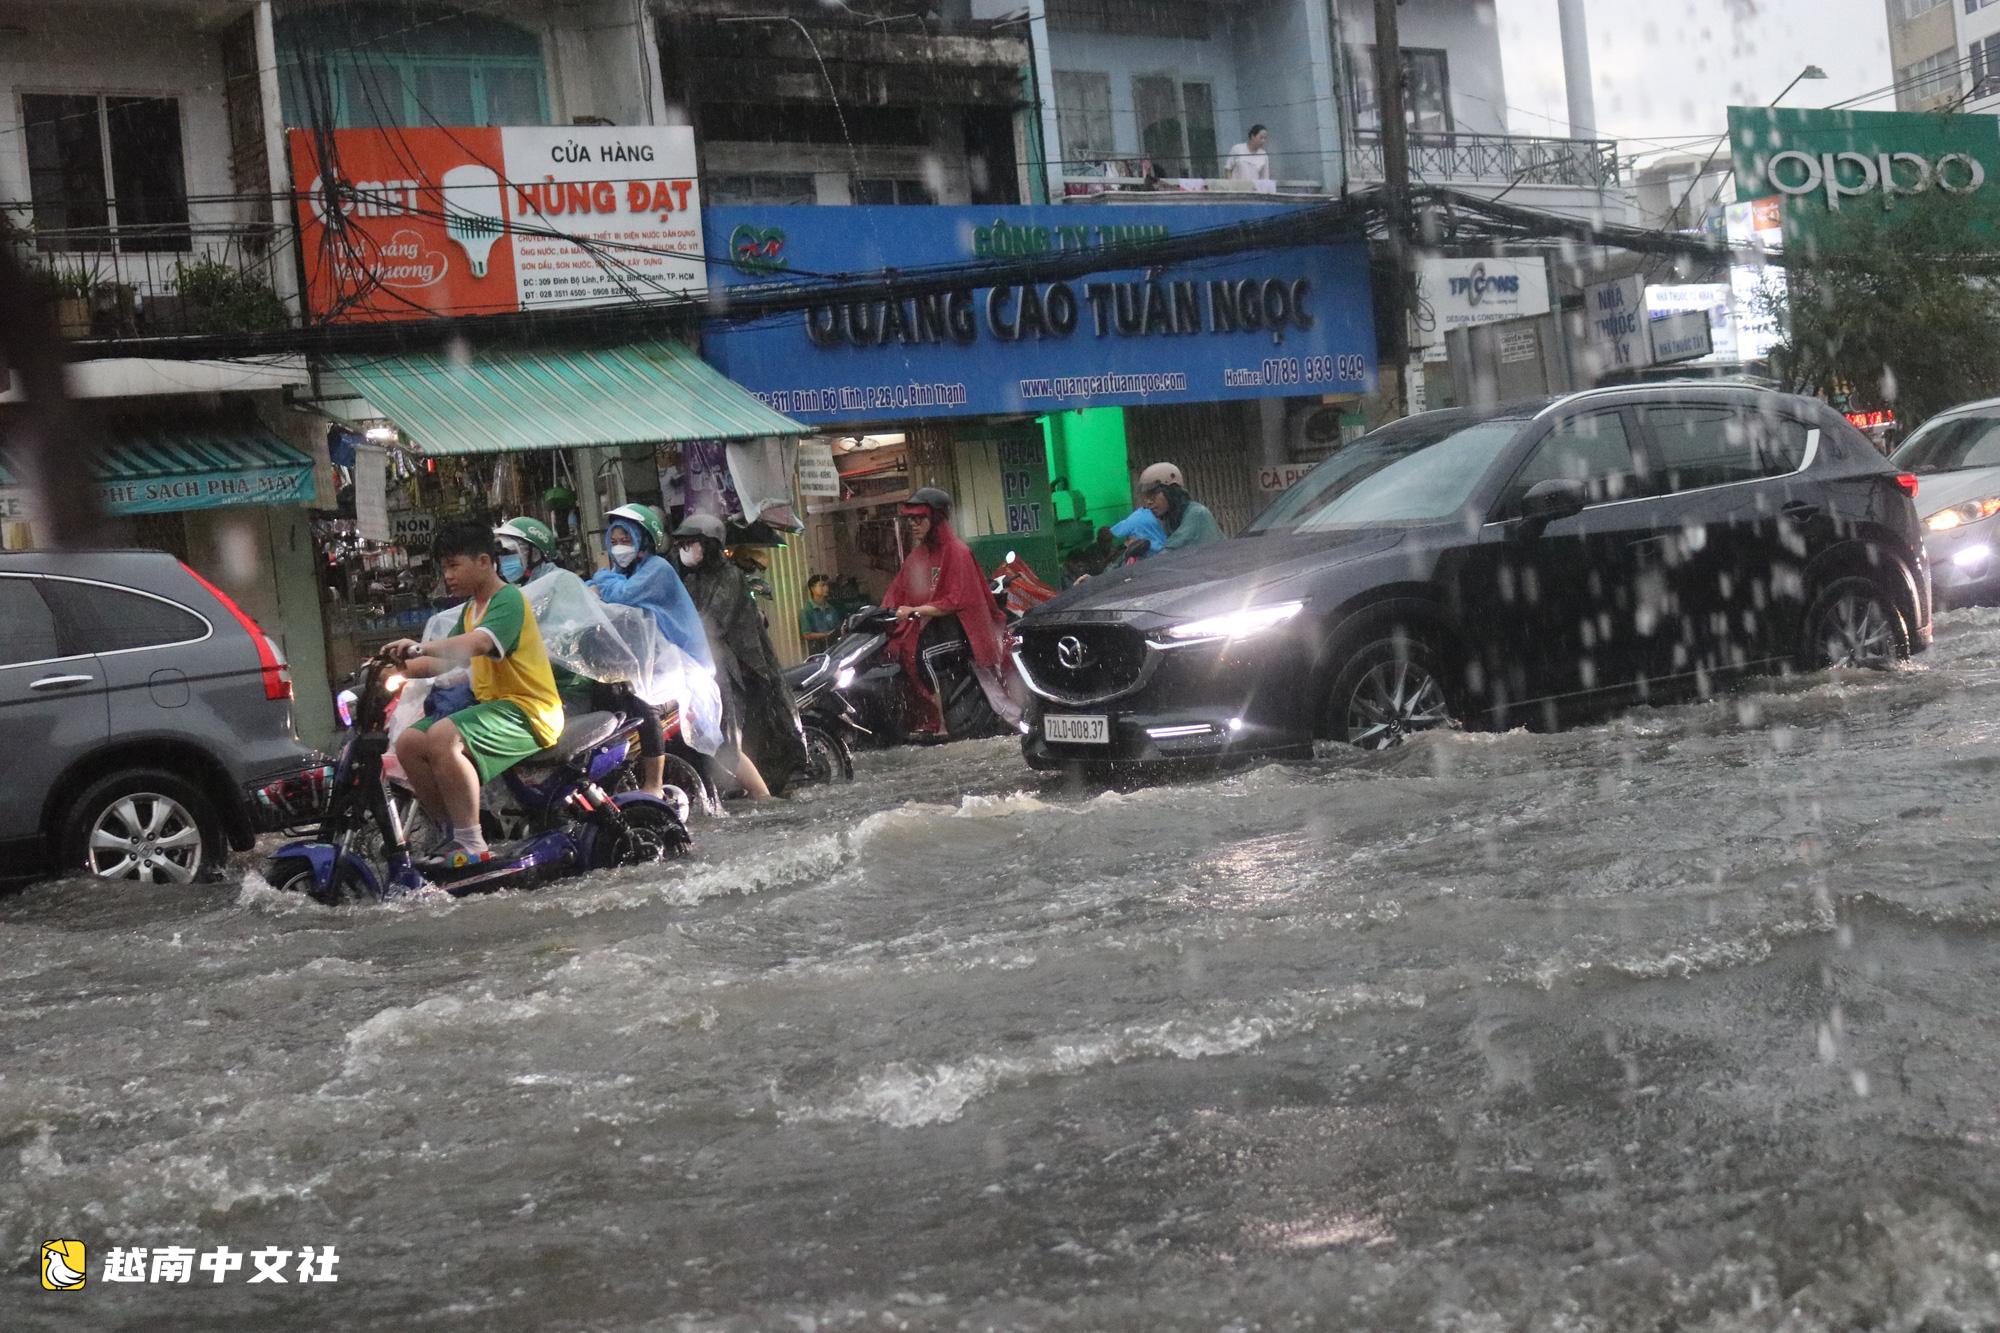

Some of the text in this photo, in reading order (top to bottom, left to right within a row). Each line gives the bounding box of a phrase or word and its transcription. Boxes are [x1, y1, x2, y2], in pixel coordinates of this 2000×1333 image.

[551, 139, 654, 163] CỬA HÀNG
[517, 174, 692, 222] HÙNG ĐẠT
[679, 271, 695, 281] HCM
[540, 288, 553, 298] 028
[1206, 277, 1315, 345] NGỌC
[1225, 354, 1365, 387] Hotline: 0789 939 949
[772, 391, 790, 412] 311
[793, 390, 820, 411] Đinh
[822, 387, 837, 414] Bộ
[935, 383, 967, 408] Thạnh
[102, 483, 137, 503] HÊ
[146, 480, 200, 504] SẠCH
[207, 477, 250, 496] PHA
[1004, 471, 1031, 499] PP
[396, 516, 430, 532] NÓN
[1007, 503, 1041, 537] BẠT
[528, 526, 549, 544] Grab
[1047, 719, 1104, 740] 72LD-008.37
